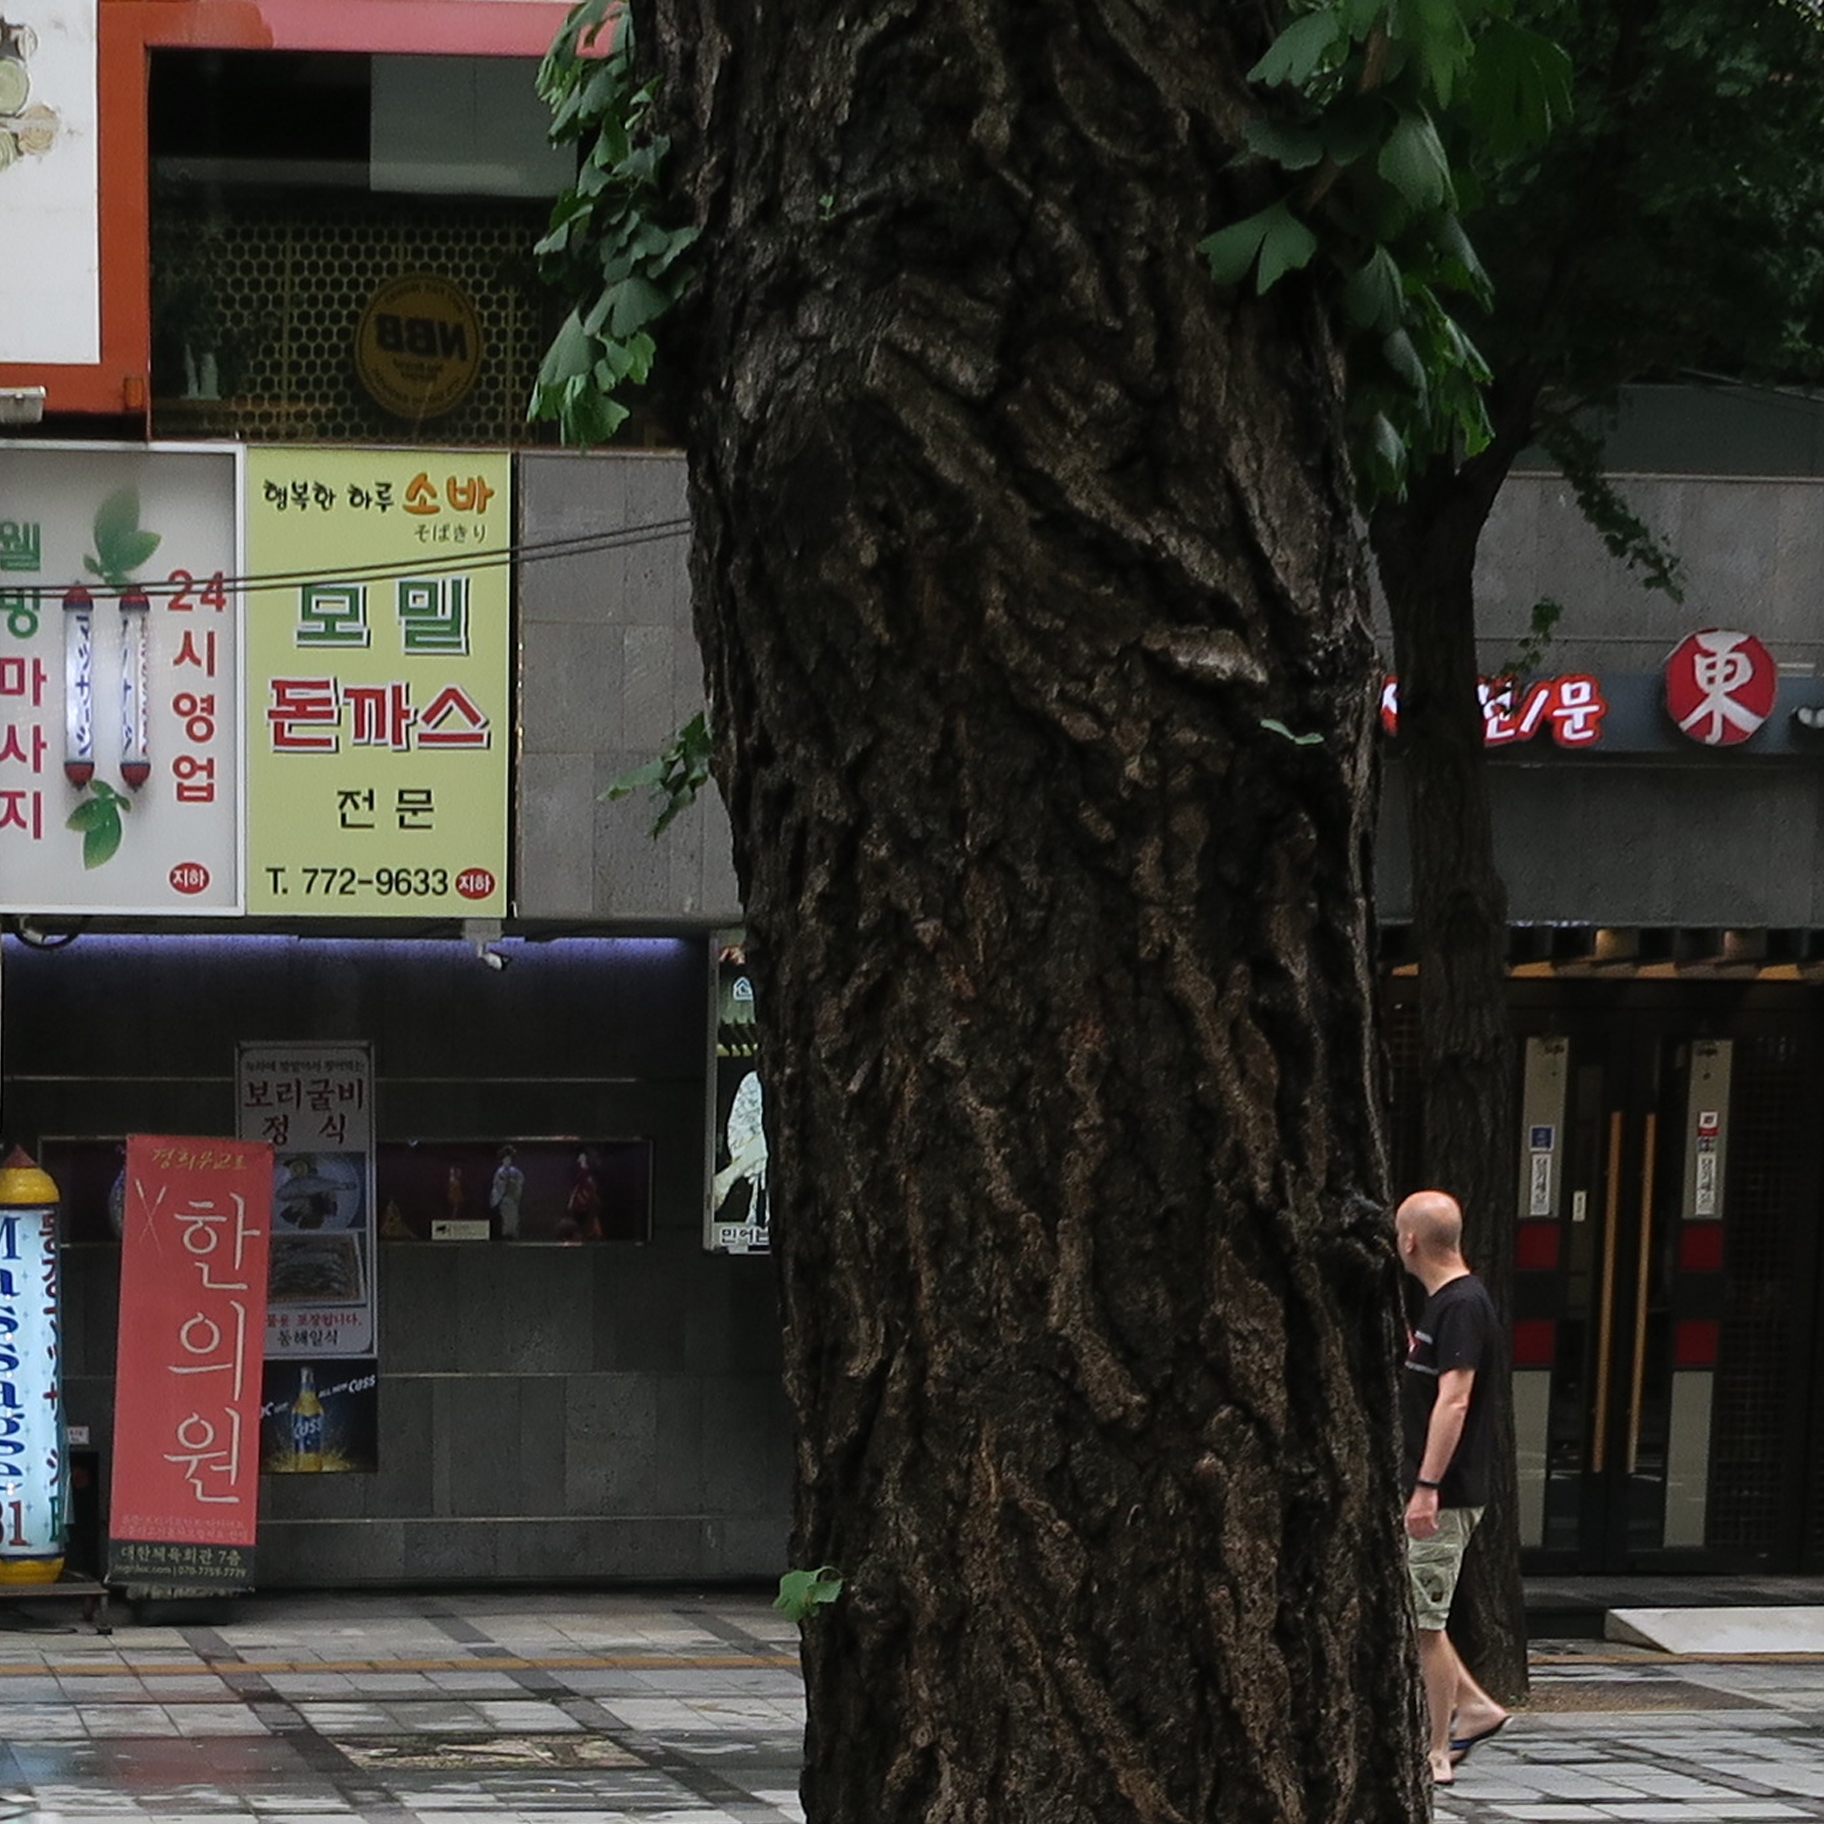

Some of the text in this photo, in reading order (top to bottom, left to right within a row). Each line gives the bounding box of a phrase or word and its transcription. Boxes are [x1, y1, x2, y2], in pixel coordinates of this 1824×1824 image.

[262, 472, 495, 516] 행복한 하루 소바
[295, 577, 471, 655] 모밀
[1677, 633, 1766, 744] 東
[266, 678, 490, 752] 돈까스
[338, 788, 435, 830] 전문
[170, 868, 206, 888] 지하
[300, 867, 450, 895] 772-9633
[459, 873, 492, 894] 지하
[243, 1078, 364, 1112] 보리굴비
[262, 1112, 347, 1147] 정식
[164, 1192, 261, 1504] 한의원
